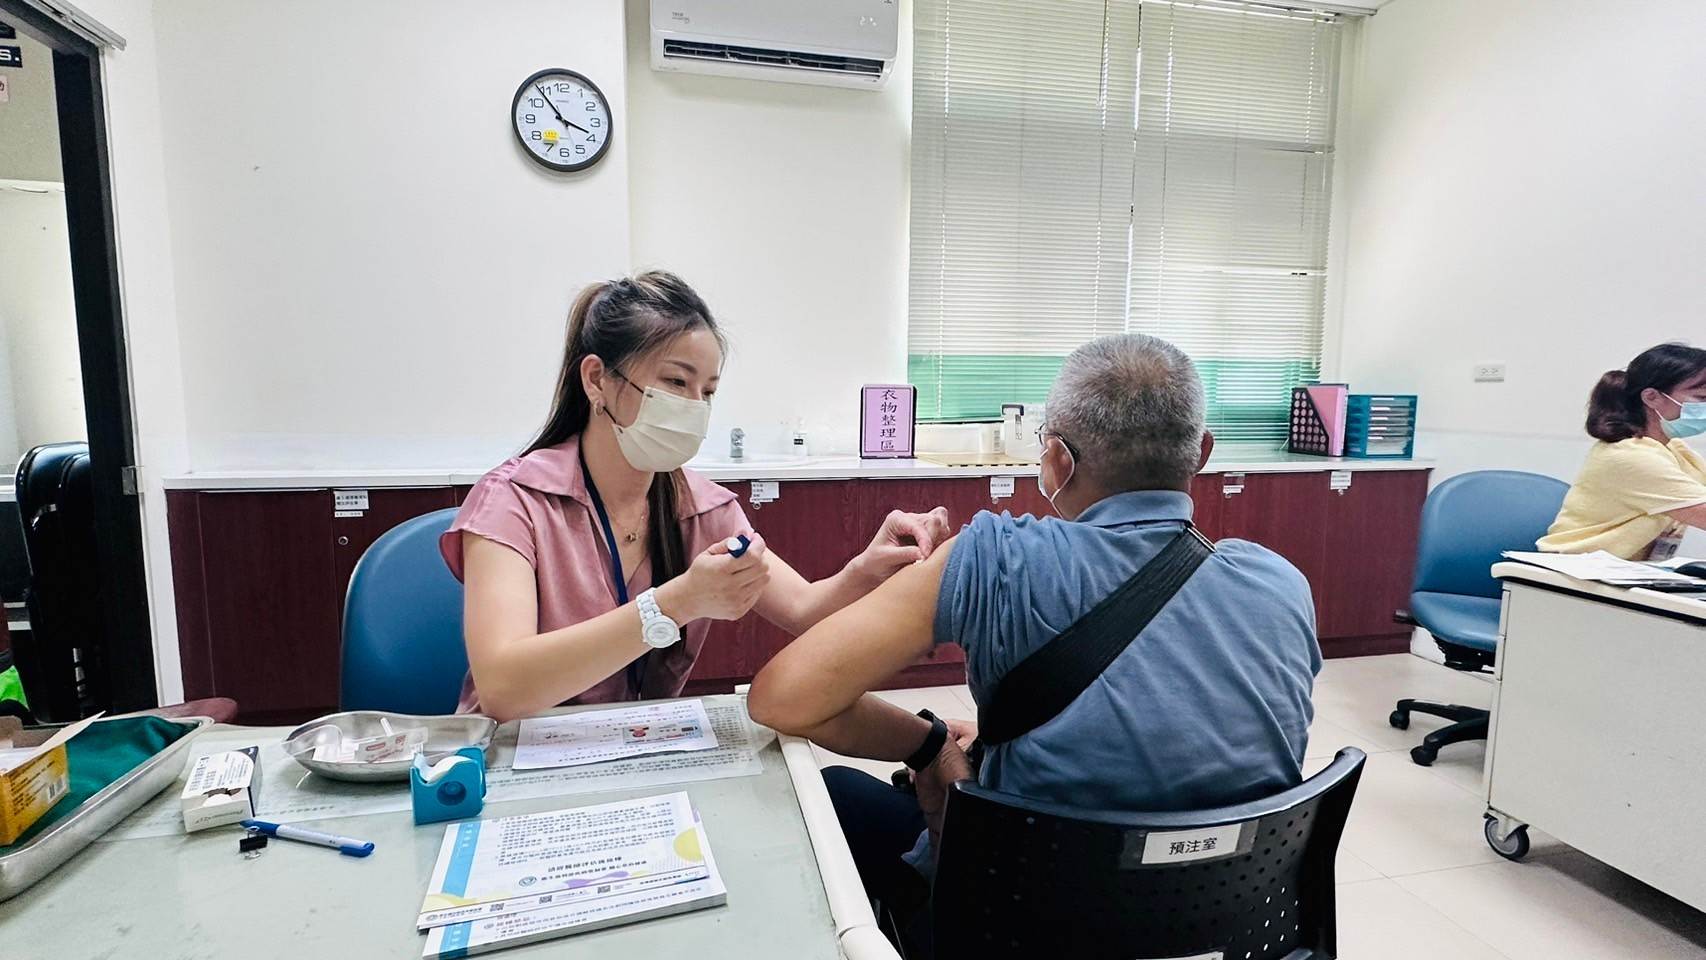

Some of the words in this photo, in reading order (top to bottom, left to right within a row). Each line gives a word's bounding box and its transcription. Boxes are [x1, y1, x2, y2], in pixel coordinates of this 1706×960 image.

[540, 86, 552, 96] 11
[554, 83, 570, 93] 12
[577, 88, 584, 98] 1
[528, 98, 544, 108] 10
[585, 101, 596, 111] 2
[525, 114, 536, 124] 9
[590, 117, 601, 128] 3
[531, 131, 542, 140] 8
[586, 134, 596, 143] 4
[543, 142, 555, 152] 7
[575, 145, 586, 154] 5
[559, 148, 570, 158] 6
[880, 389, 898, 451] 衣物整理區
[1168, 837, 1218, 855] 預注室
